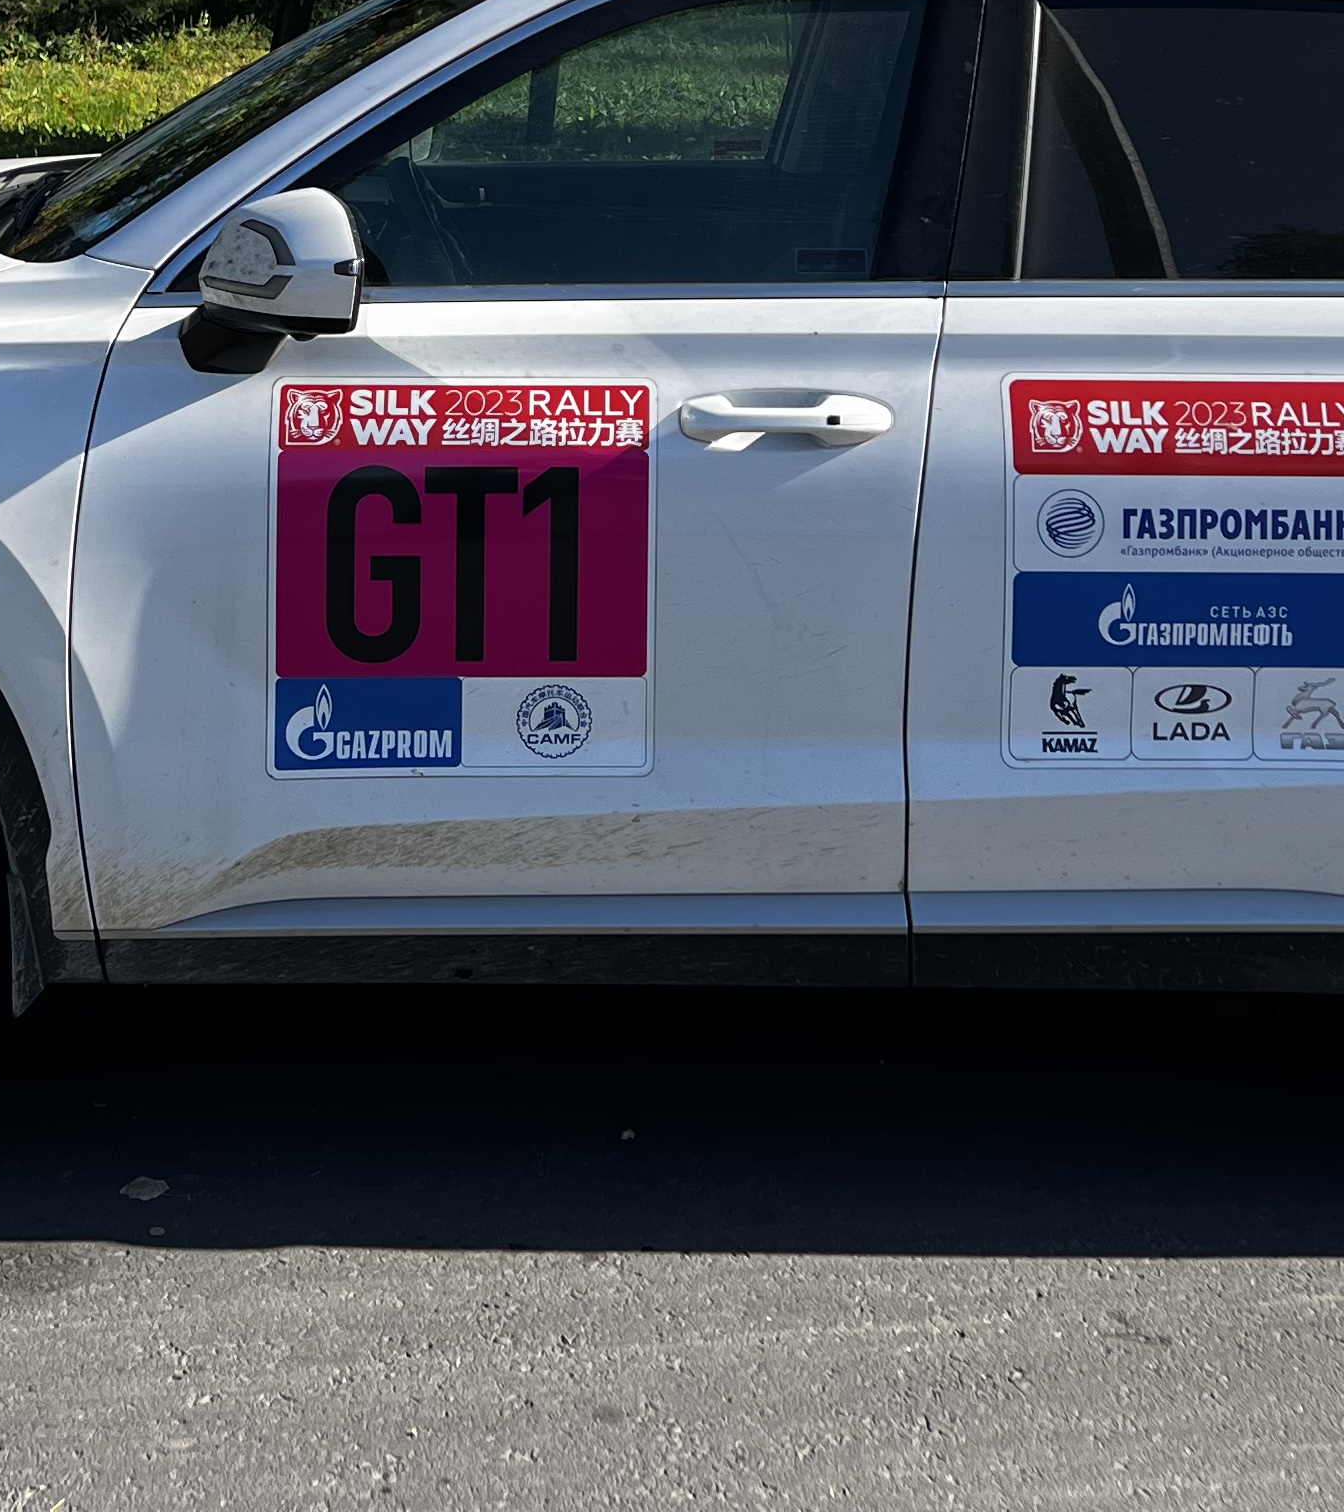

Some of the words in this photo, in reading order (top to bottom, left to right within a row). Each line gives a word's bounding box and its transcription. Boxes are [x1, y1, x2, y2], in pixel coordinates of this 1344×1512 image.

[349, 389, 437, 416] SILK
[445, 389, 524, 417] 2023
[529, 389, 644, 417] RALLY
[1087, 400, 1168, 427] SILK
[1174, 401, 1248, 428] 2023
[350, 418, 434, 446] WAY
[441, 417, 645, 448] 丝绸之路拉力赛
[1088, 428, 1168, 454] WAY
[325, 464, 580, 664] GT1
[1120, 545, 1209, 560] «Газпромбанк»
[1211, 545, 1296, 560] (Акционерное
[1209, 605, 1252, 620] СЕТЬ
[1255, 605, 1289, 620] АЗС
[1136, 622, 1294, 648] ГАЗПРОМНЕФТЬ
[336, 729, 453, 760] GAZPROM
[527, 733, 581, 745] CAMF
[1153, 721, 1232, 742] LADA
[1041, 737, 1099, 754] KAMAZ
